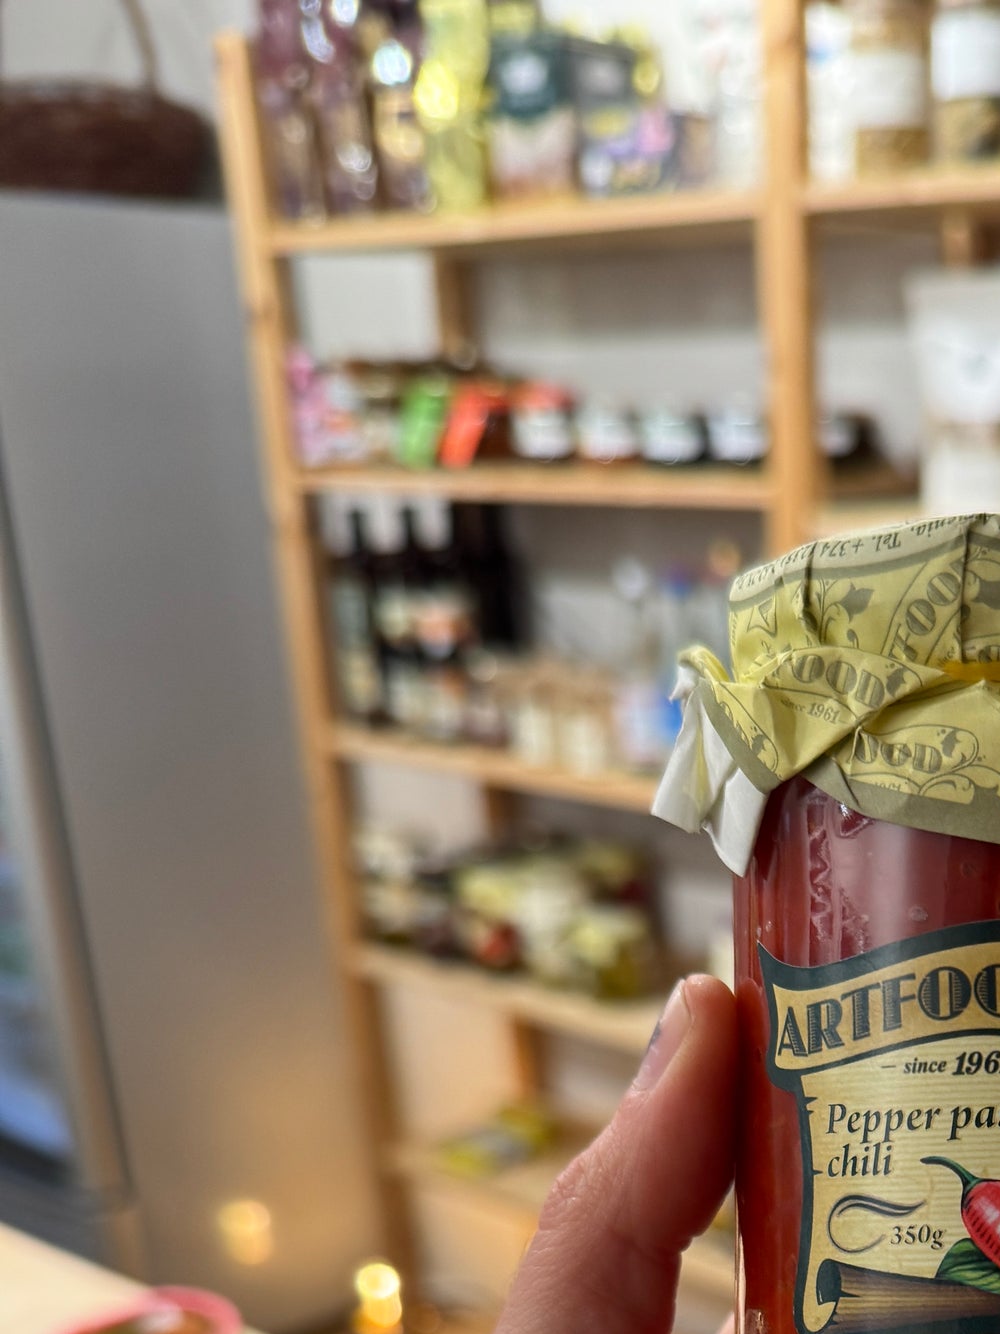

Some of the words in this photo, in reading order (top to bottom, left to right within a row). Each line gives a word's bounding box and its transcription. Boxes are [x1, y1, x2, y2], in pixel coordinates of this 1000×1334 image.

[871, 532, 902, 552] Tel.
[807, 702, 841, 725] 1961
[903, 1056, 947, 1075] since
[825, 1102, 941, 1144] Pepper
[827, 1143, 894, 1179] chili
[889, 1224, 945, 1249] 350g
